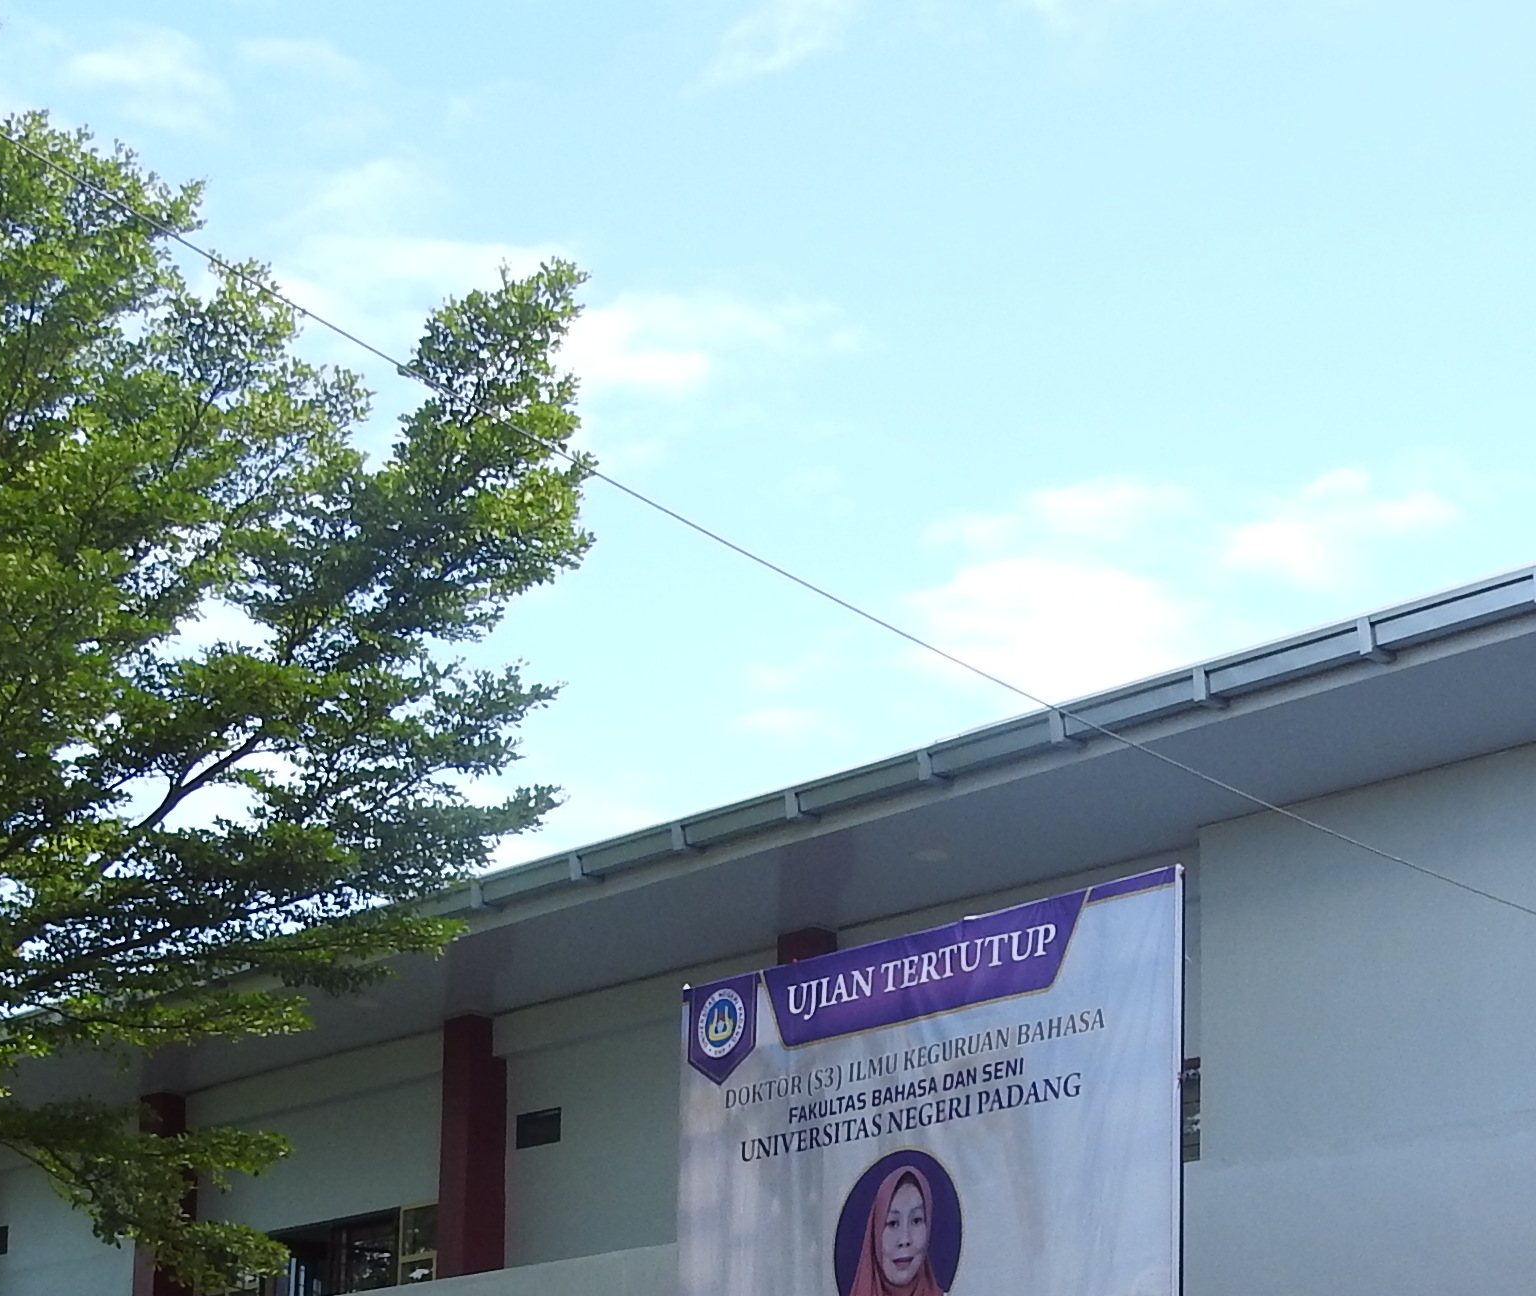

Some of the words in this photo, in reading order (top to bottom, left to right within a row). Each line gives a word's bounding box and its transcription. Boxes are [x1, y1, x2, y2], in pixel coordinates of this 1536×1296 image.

[787, 966, 875, 1020] UJIAN
[880, 923, 1057, 993] TERTUTUP
[724, 1072, 802, 1109] DOKTOR
[807, 1064, 843, 1097] (S3)
[848, 1053, 898, 1083] ILMU
[902, 1027, 1010, 1071] KEGURUAN
[1015, 1007, 1105, 1046] BAHASA
[788, 1093, 866, 1125] FAKULTAS
[870, 1079, 938, 1107] BAHASA
[941, 1070, 977, 1095] DAN
[981, 1058, 1025, 1084] SENI
[740, 1115, 882, 1163] UNIVERSITAS
[887, 1097, 971, 1135] NEGERI
[976, 1072, 1081, 1116] PADANG
